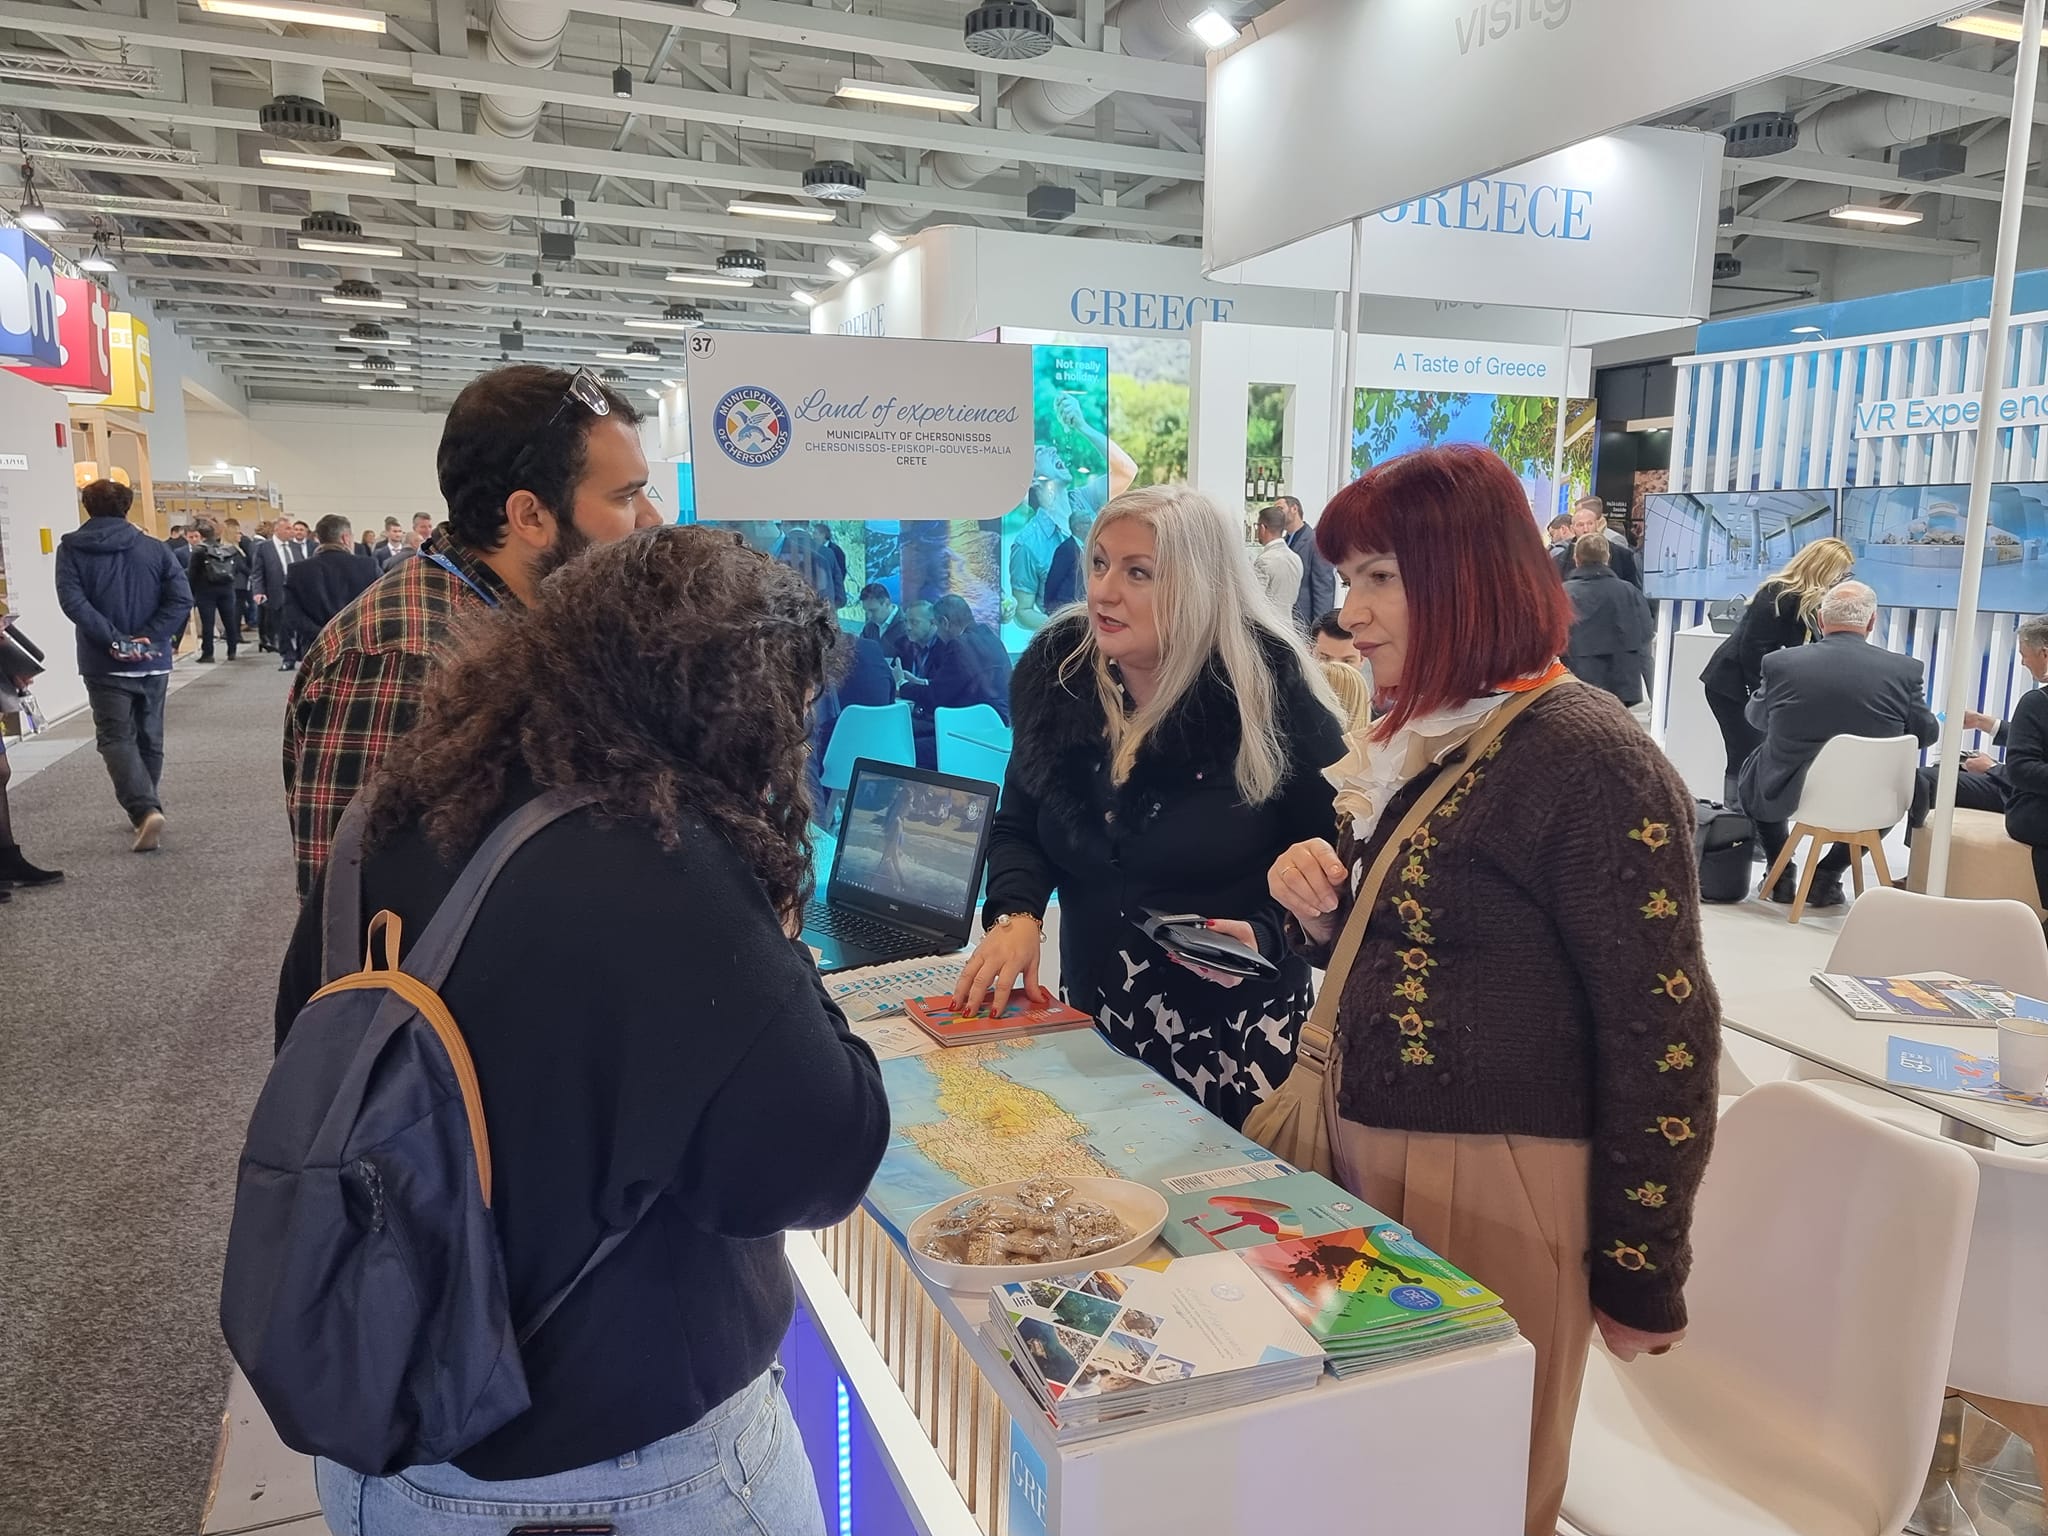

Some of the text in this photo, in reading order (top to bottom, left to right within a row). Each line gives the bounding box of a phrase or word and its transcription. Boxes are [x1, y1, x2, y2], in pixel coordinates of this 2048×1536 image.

[1070, 287, 1234, 331] GREECE
[692, 337, 712, 352] 37
[1055, 358, 1101, 373] Not really
[1055, 372, 1063, 381] a
[1393, 352, 1547, 377] A Taste of Greece
[719, 390, 786, 417] MUNICIPALITY
[794, 388, 1019, 427] Land of experiences
[1858, 394, 2048, 432] VR Expeen
[718, 428, 788, 463] OF CHERSONISSOS
[805, 442, 1011, 455] CHERSONISSOS-EPISKOPI-GOUVES-MALIA
[826, 430, 991, 442] MUNICIPALITY OF CHERSONISSOS
[896, 456, 927, 465] CRETE
[1142, 1083, 1204, 1125] CRETE
